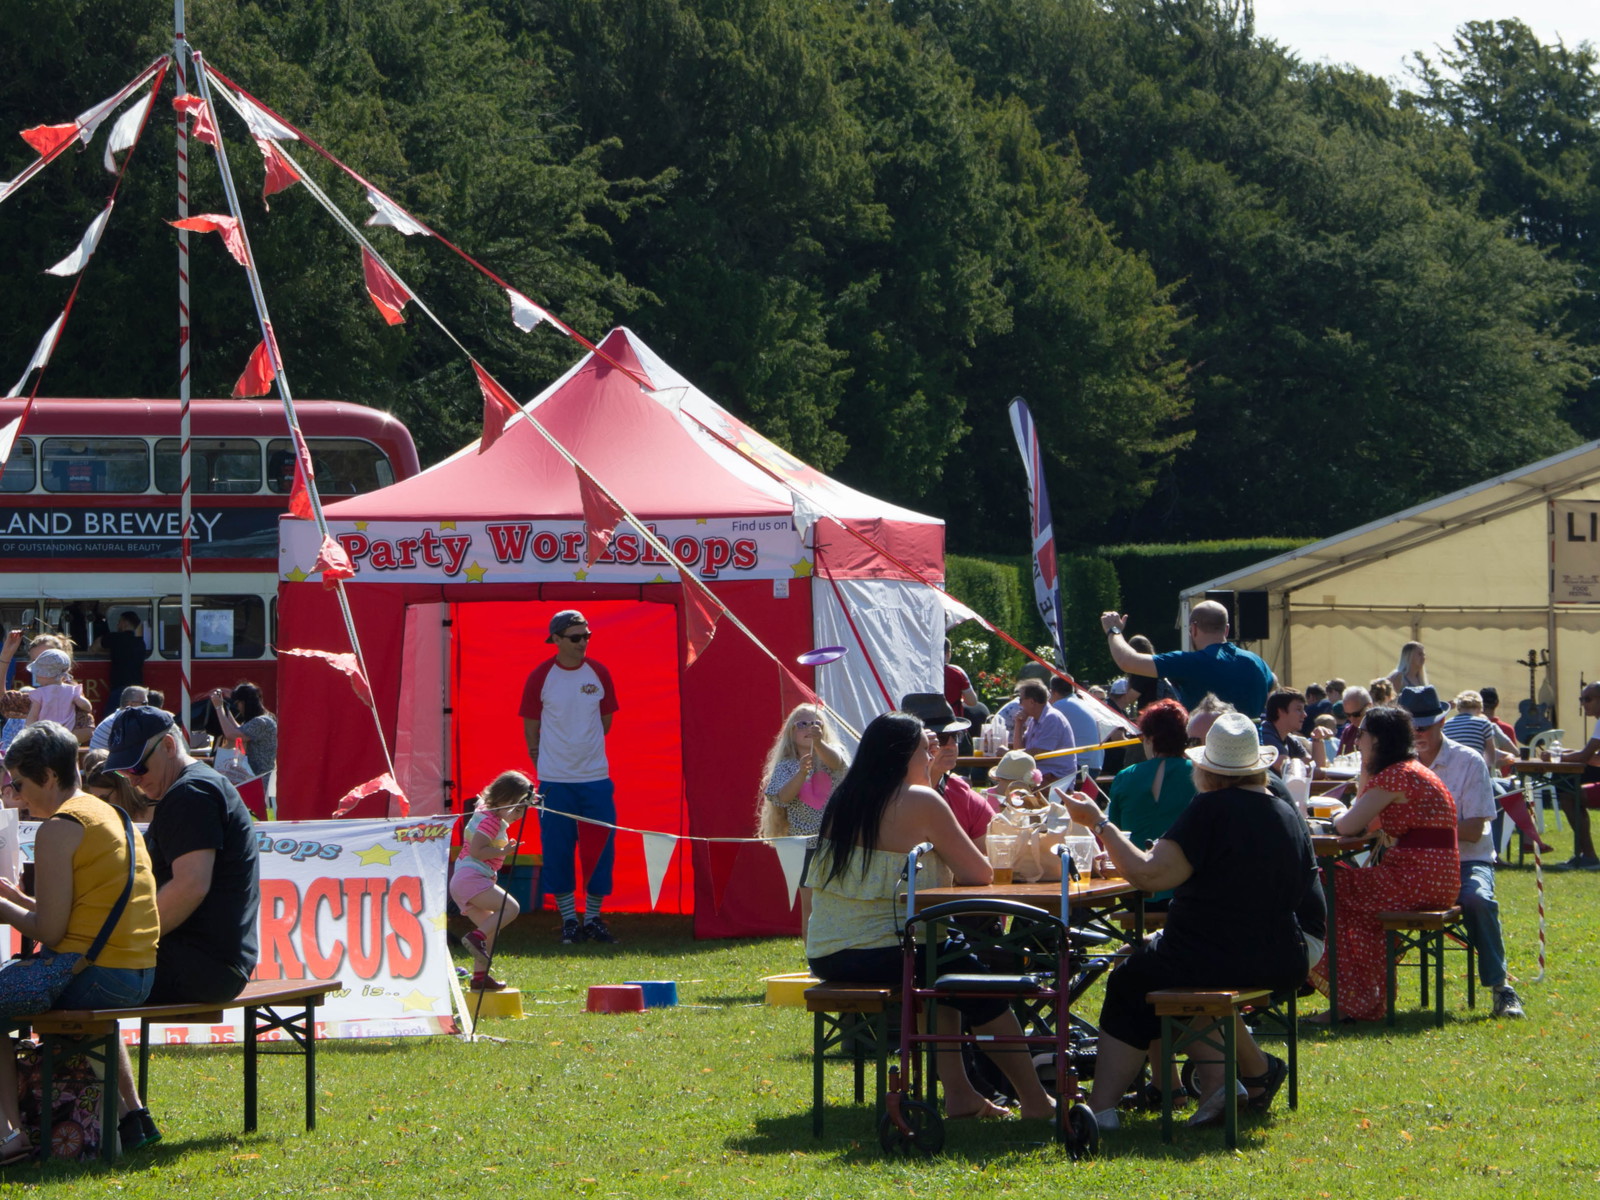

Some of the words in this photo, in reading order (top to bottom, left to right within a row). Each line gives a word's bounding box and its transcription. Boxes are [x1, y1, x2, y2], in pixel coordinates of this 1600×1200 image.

[0, 512, 73, 534] AND
[732, 520, 757, 532] Find
[758, 522, 772, 531] us
[774, 521, 788, 531] on
[2, 543, 16, 552] OF
[18, 543, 83, 552] OUTSTANDING
[85, 543, 125, 552] NATURAL
[127, 543, 162, 552] BEAUTY
[336, 529, 472, 577] Party
[250, 875, 426, 980] RCUS
